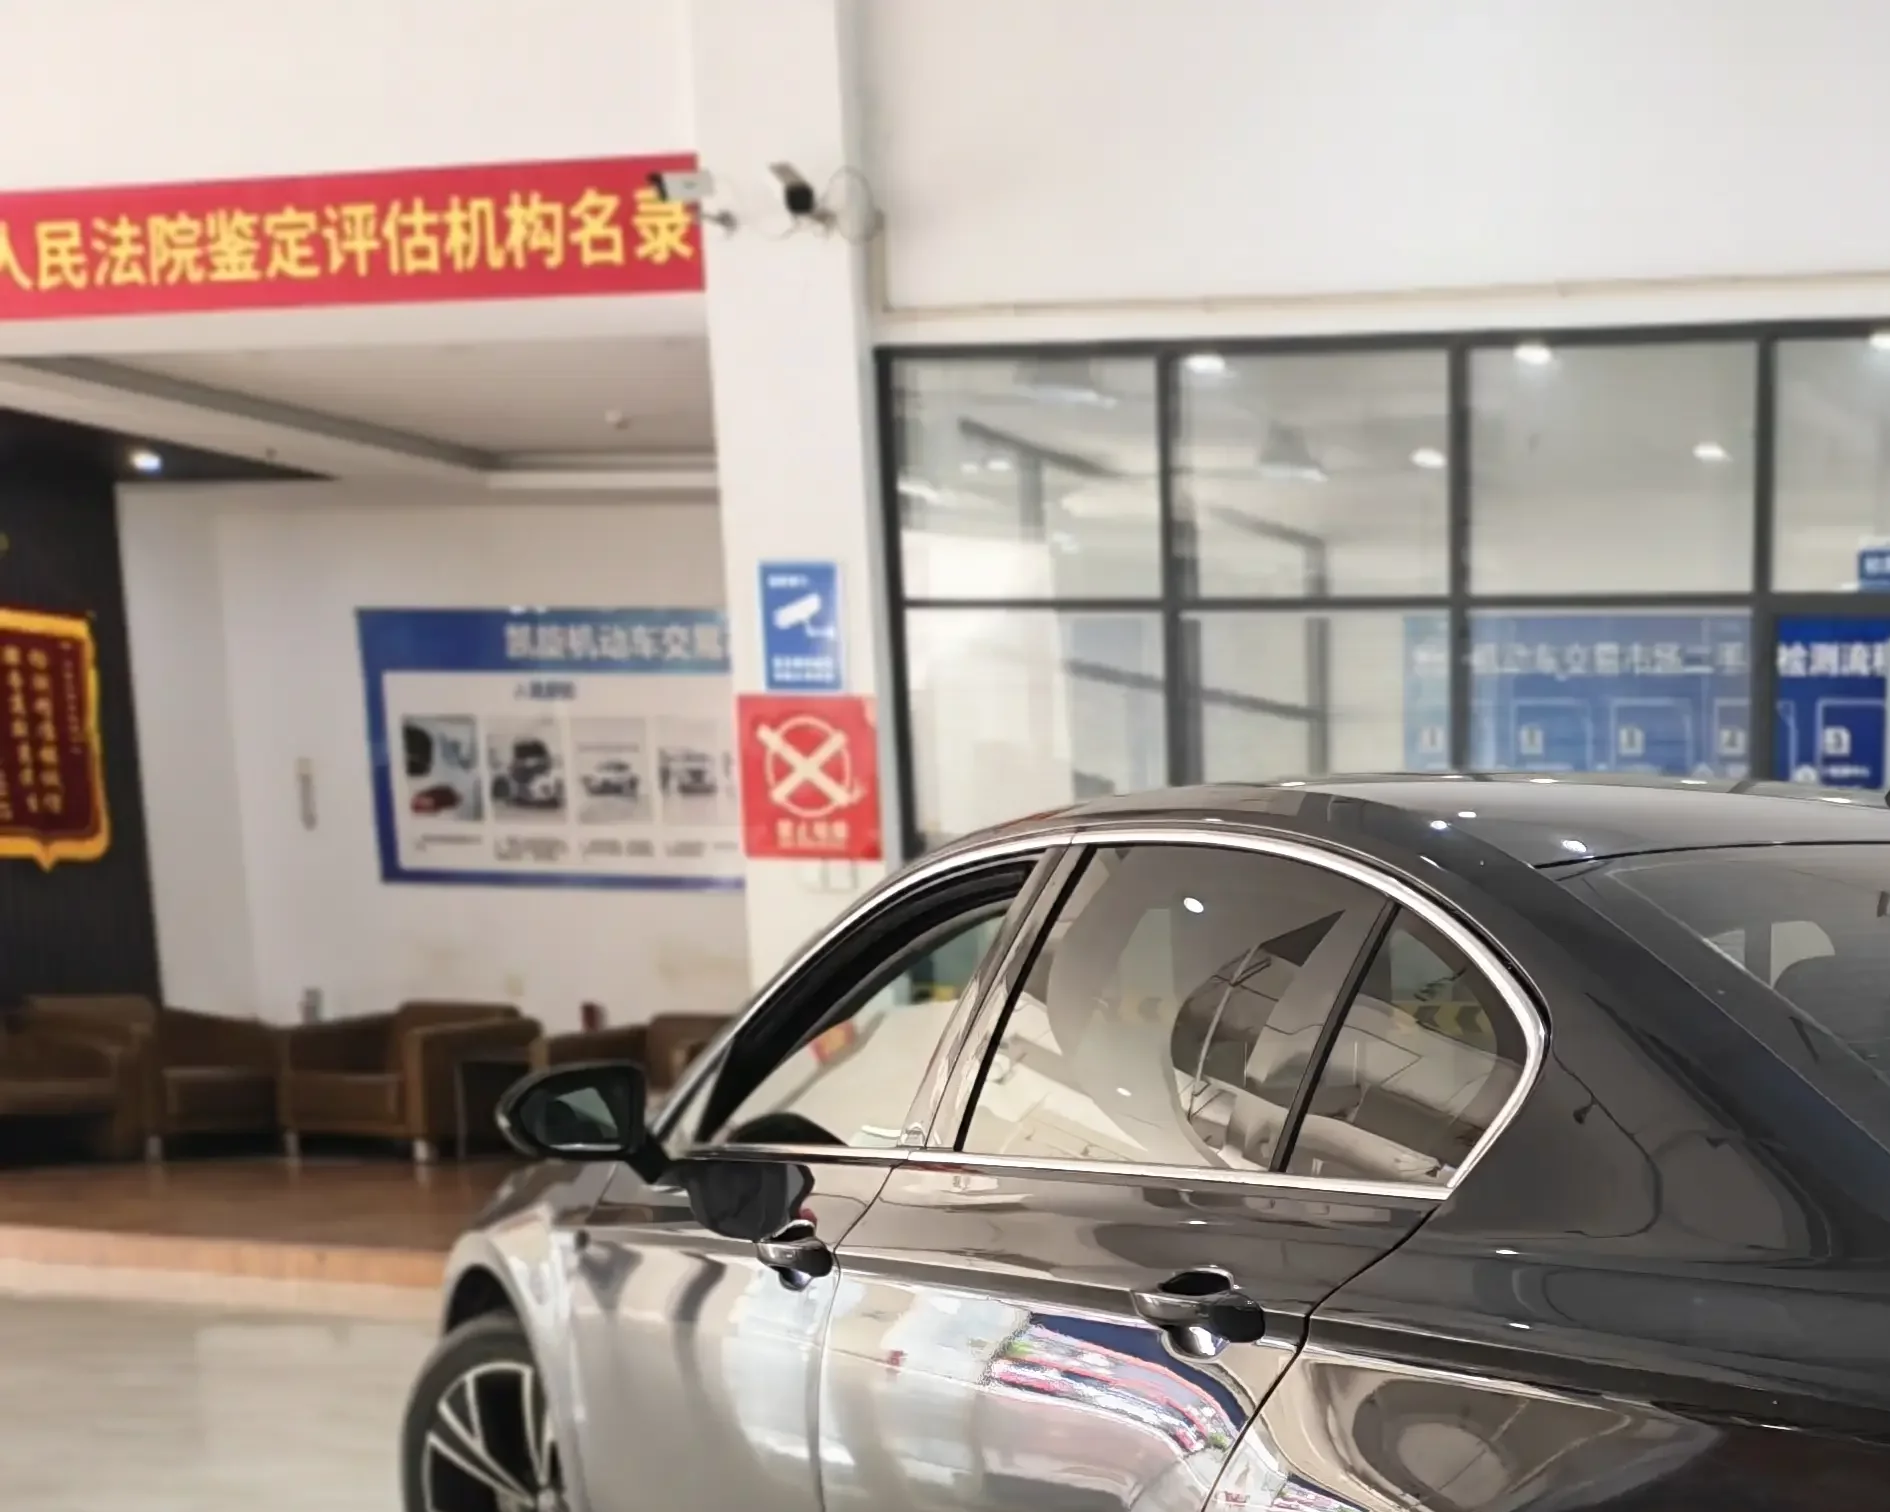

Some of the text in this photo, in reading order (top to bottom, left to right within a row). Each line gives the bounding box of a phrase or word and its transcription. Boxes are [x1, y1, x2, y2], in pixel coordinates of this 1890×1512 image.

[503, 621, 731, 662] 凯旋机动车交易
